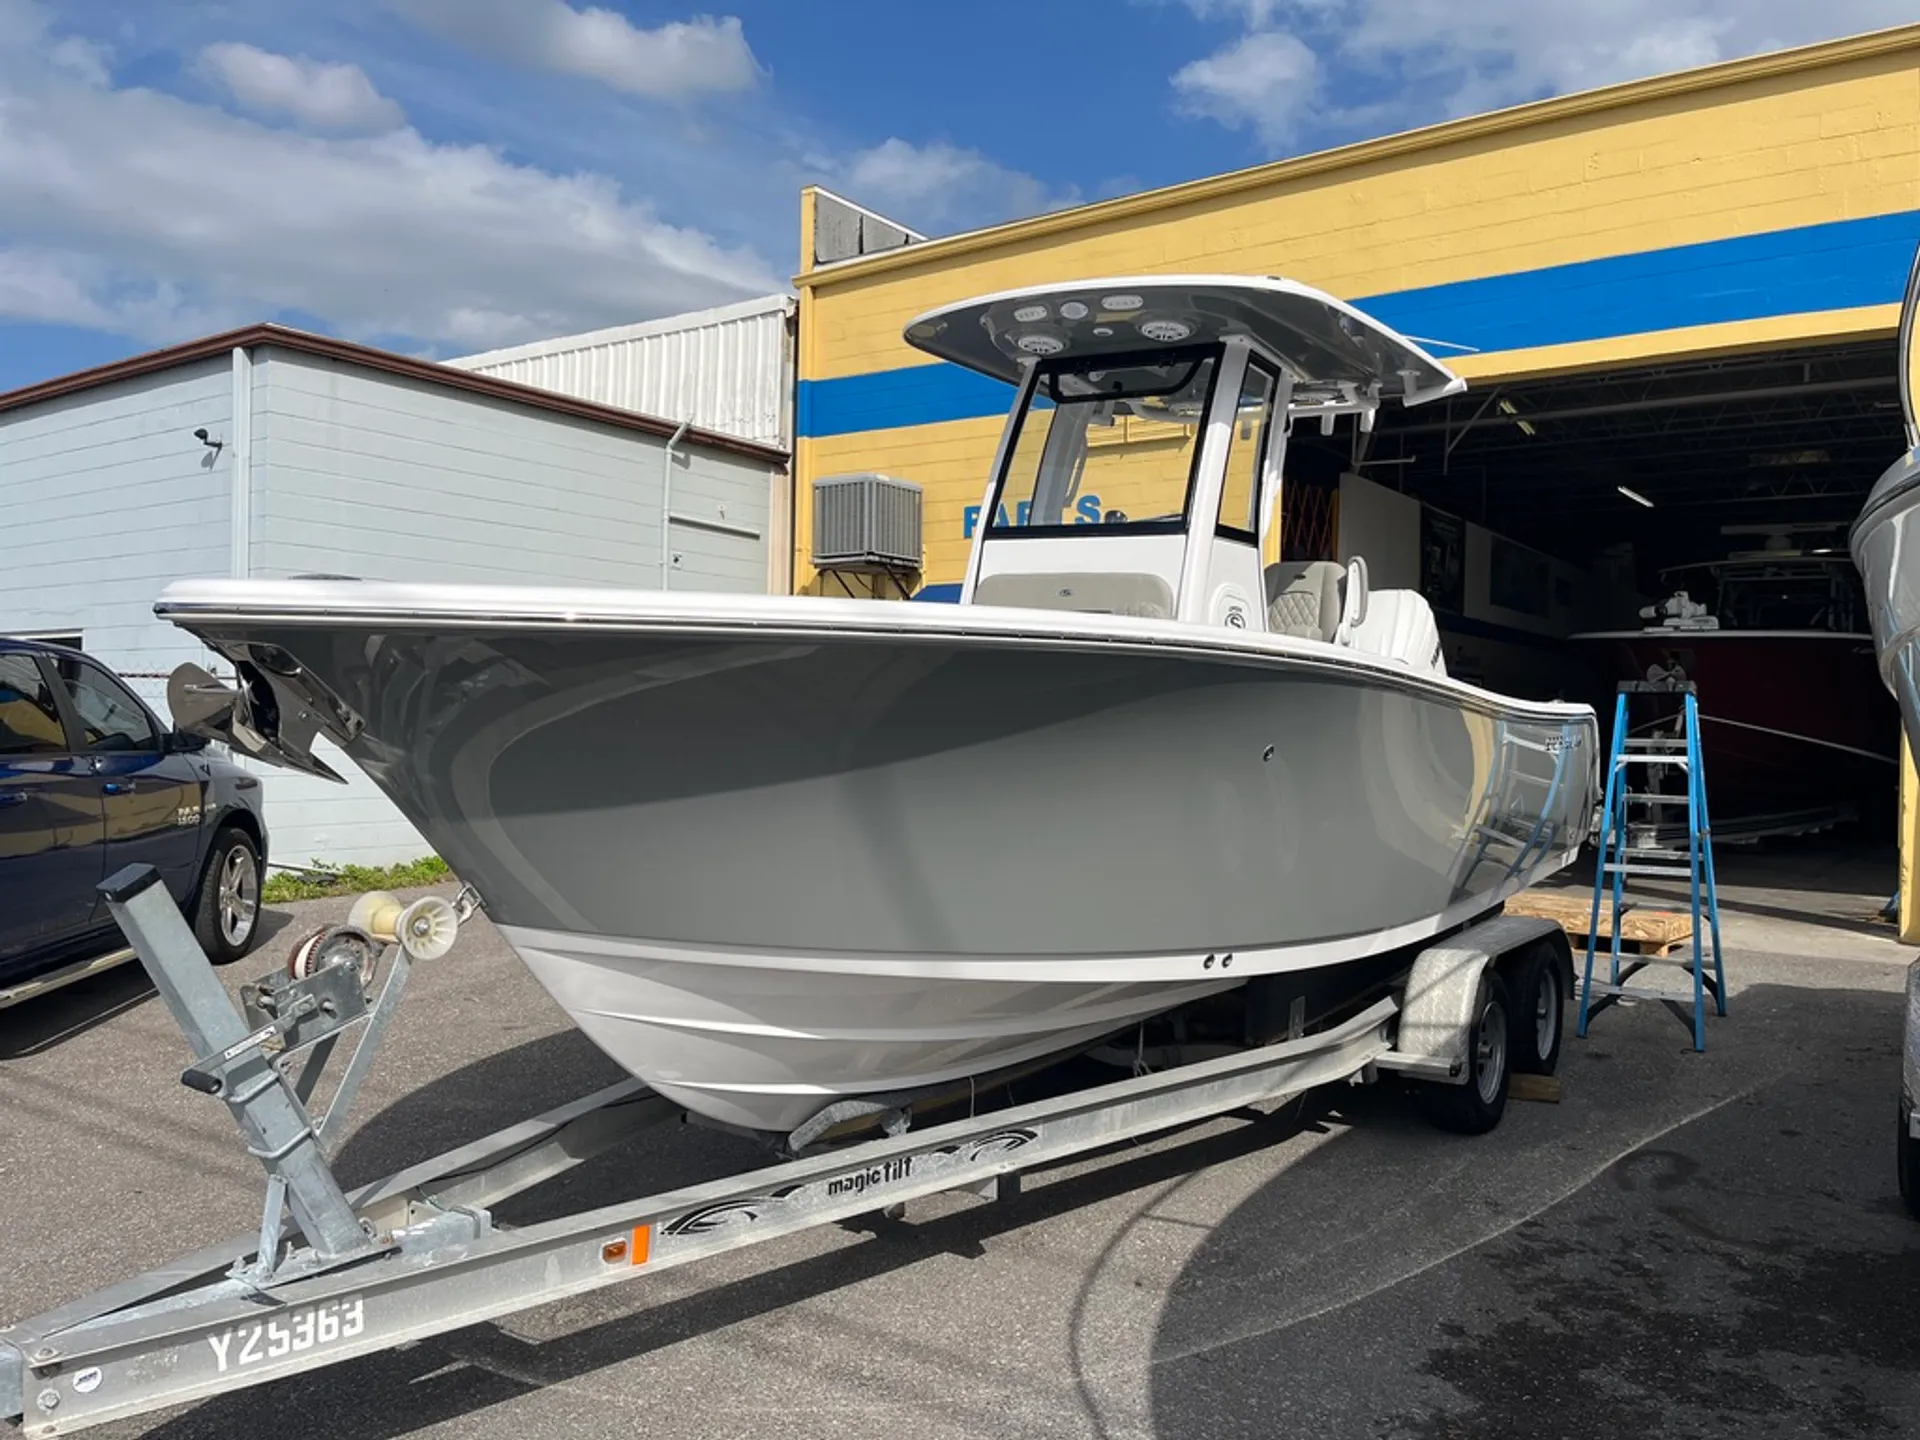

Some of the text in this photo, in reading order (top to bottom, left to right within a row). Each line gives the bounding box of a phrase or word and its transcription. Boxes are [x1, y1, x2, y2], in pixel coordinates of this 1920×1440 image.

[828, 1156, 912, 1195] magic tilt
[207, 1293, 365, 1372] Y25363
